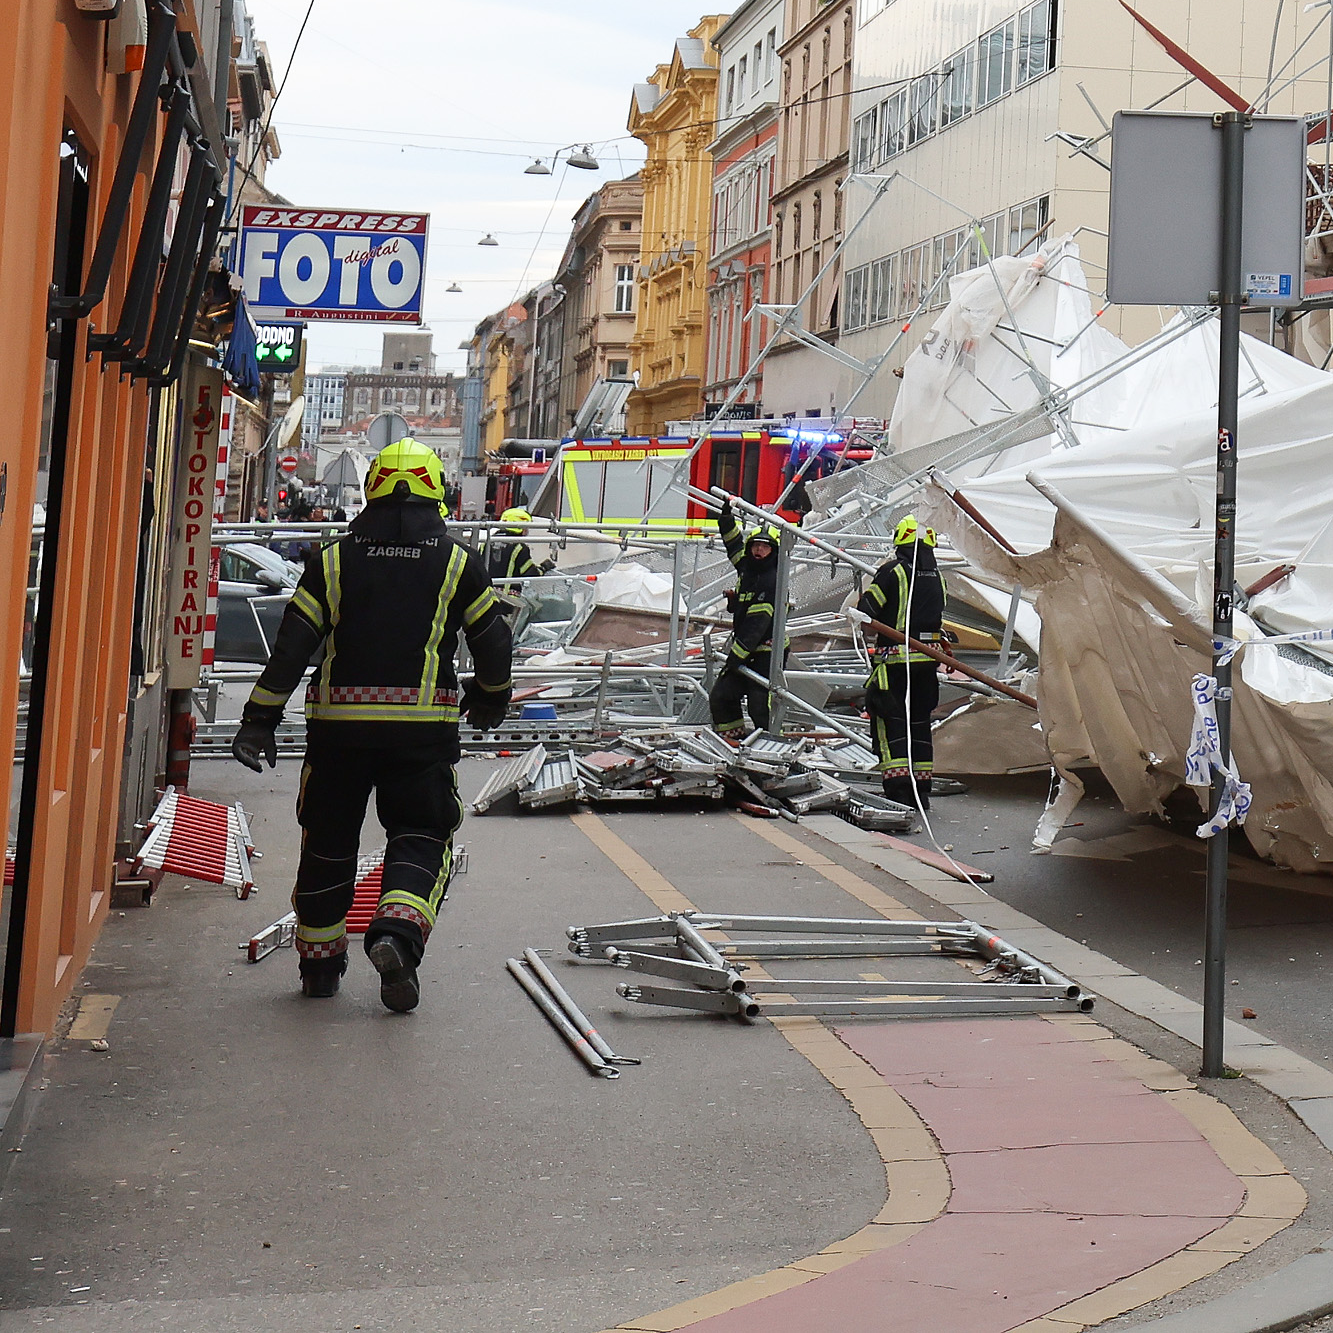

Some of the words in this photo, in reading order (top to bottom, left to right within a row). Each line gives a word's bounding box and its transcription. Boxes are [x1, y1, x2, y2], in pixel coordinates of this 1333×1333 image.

[252, 210, 421, 232] EXSPRESS
[344, 239, 399, 267] digital
[244, 232, 420, 308] FOTO
[311, 310, 379, 320] Augustini
[366, 546, 421, 559] ZAGREB
